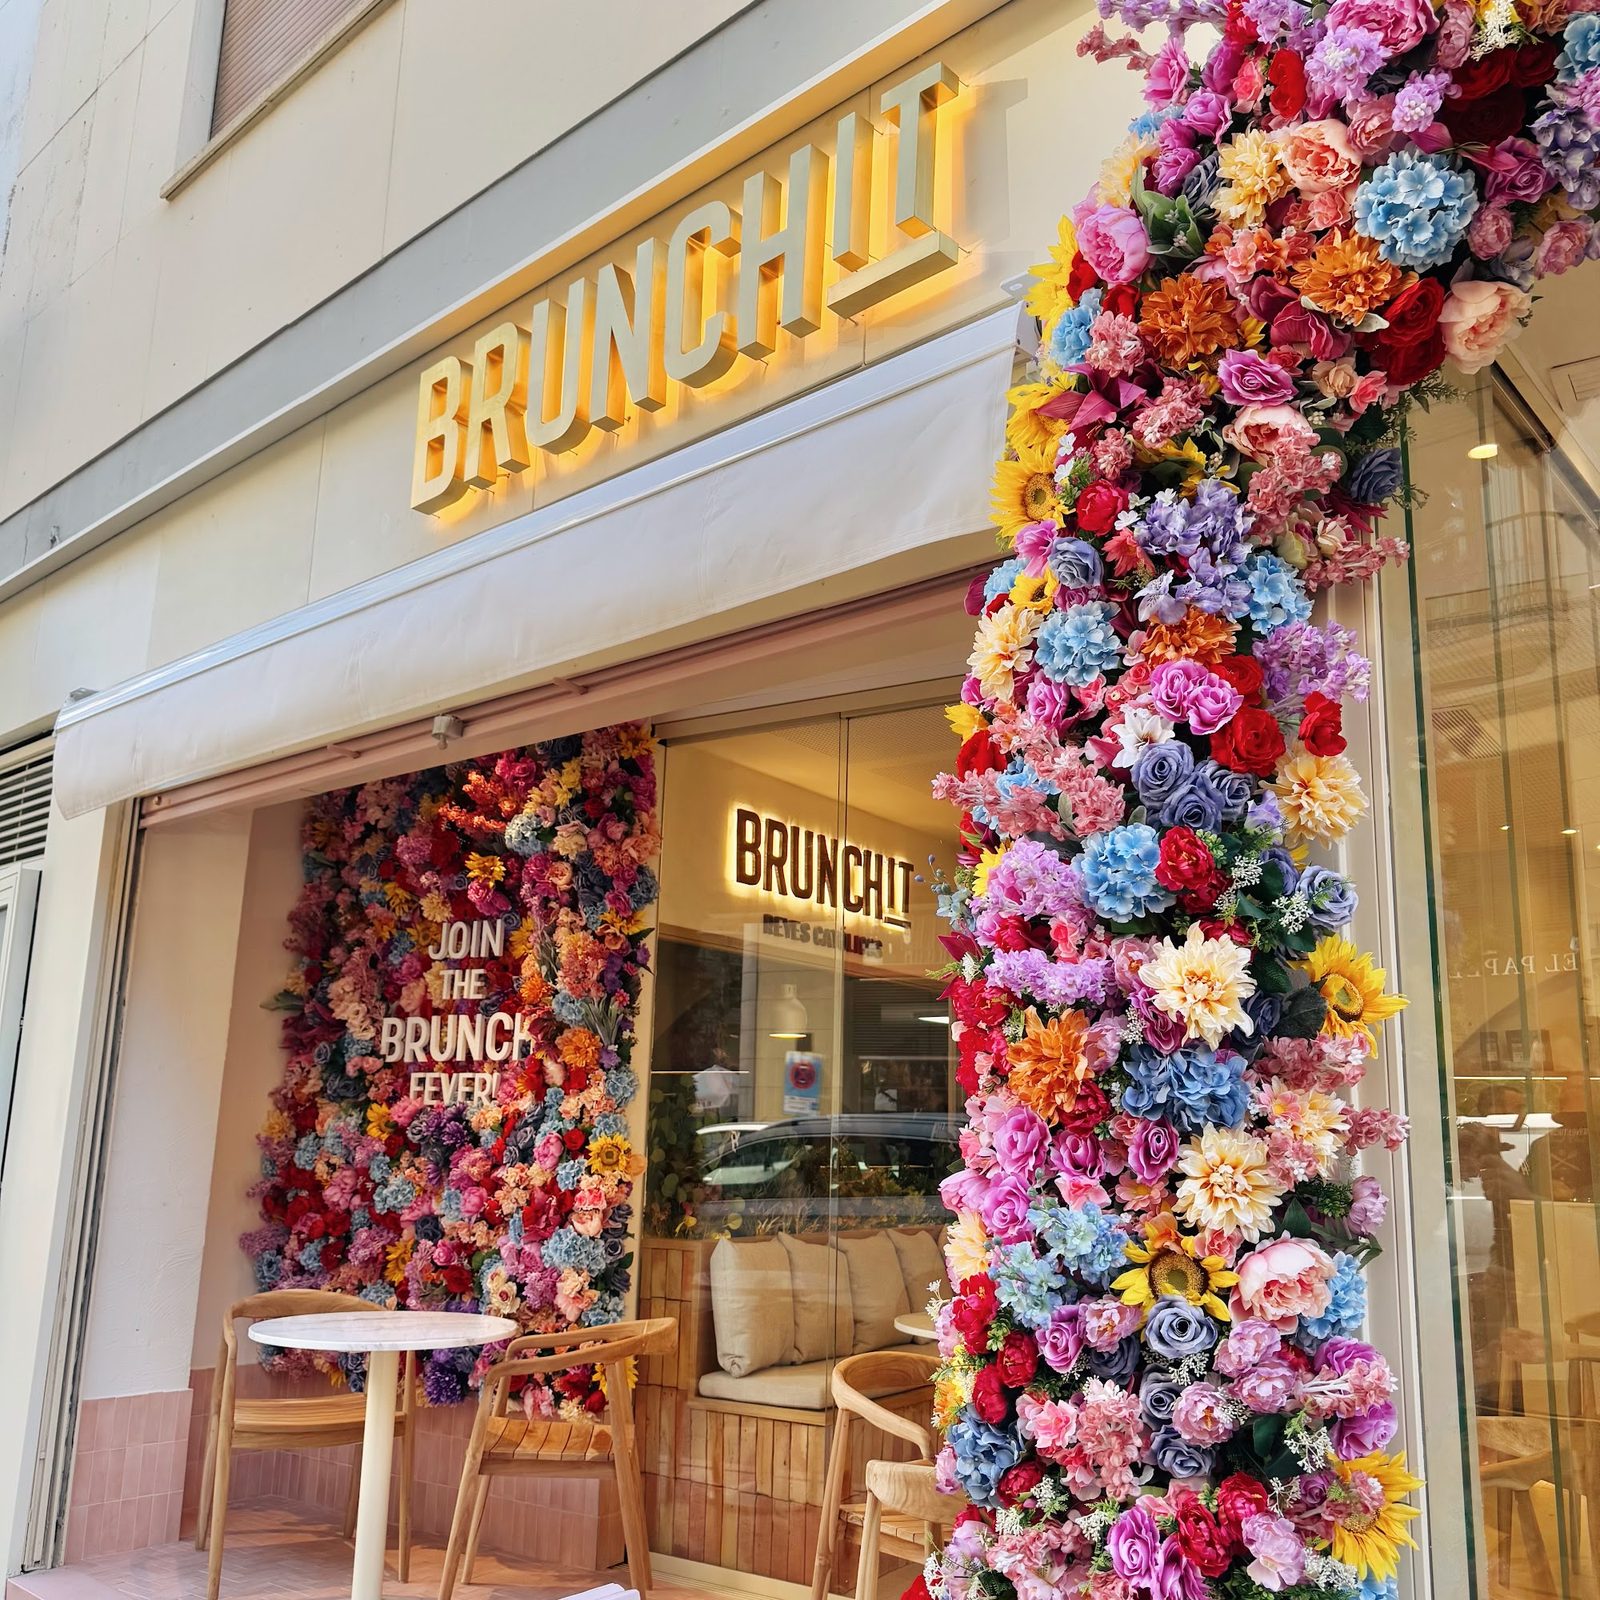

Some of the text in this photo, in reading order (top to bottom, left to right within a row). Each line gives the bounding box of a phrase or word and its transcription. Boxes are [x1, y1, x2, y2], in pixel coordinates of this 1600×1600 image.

[411, 61, 960, 516] BRUNCHIT
[736, 808, 914, 927] BRUNCHIT
[428, 918, 505, 961] JOIN
[438, 968, 486, 1000] THE
[380, 1012, 534, 1064] BRUNCH
[409, 1072, 501, 1107] FEVER!
